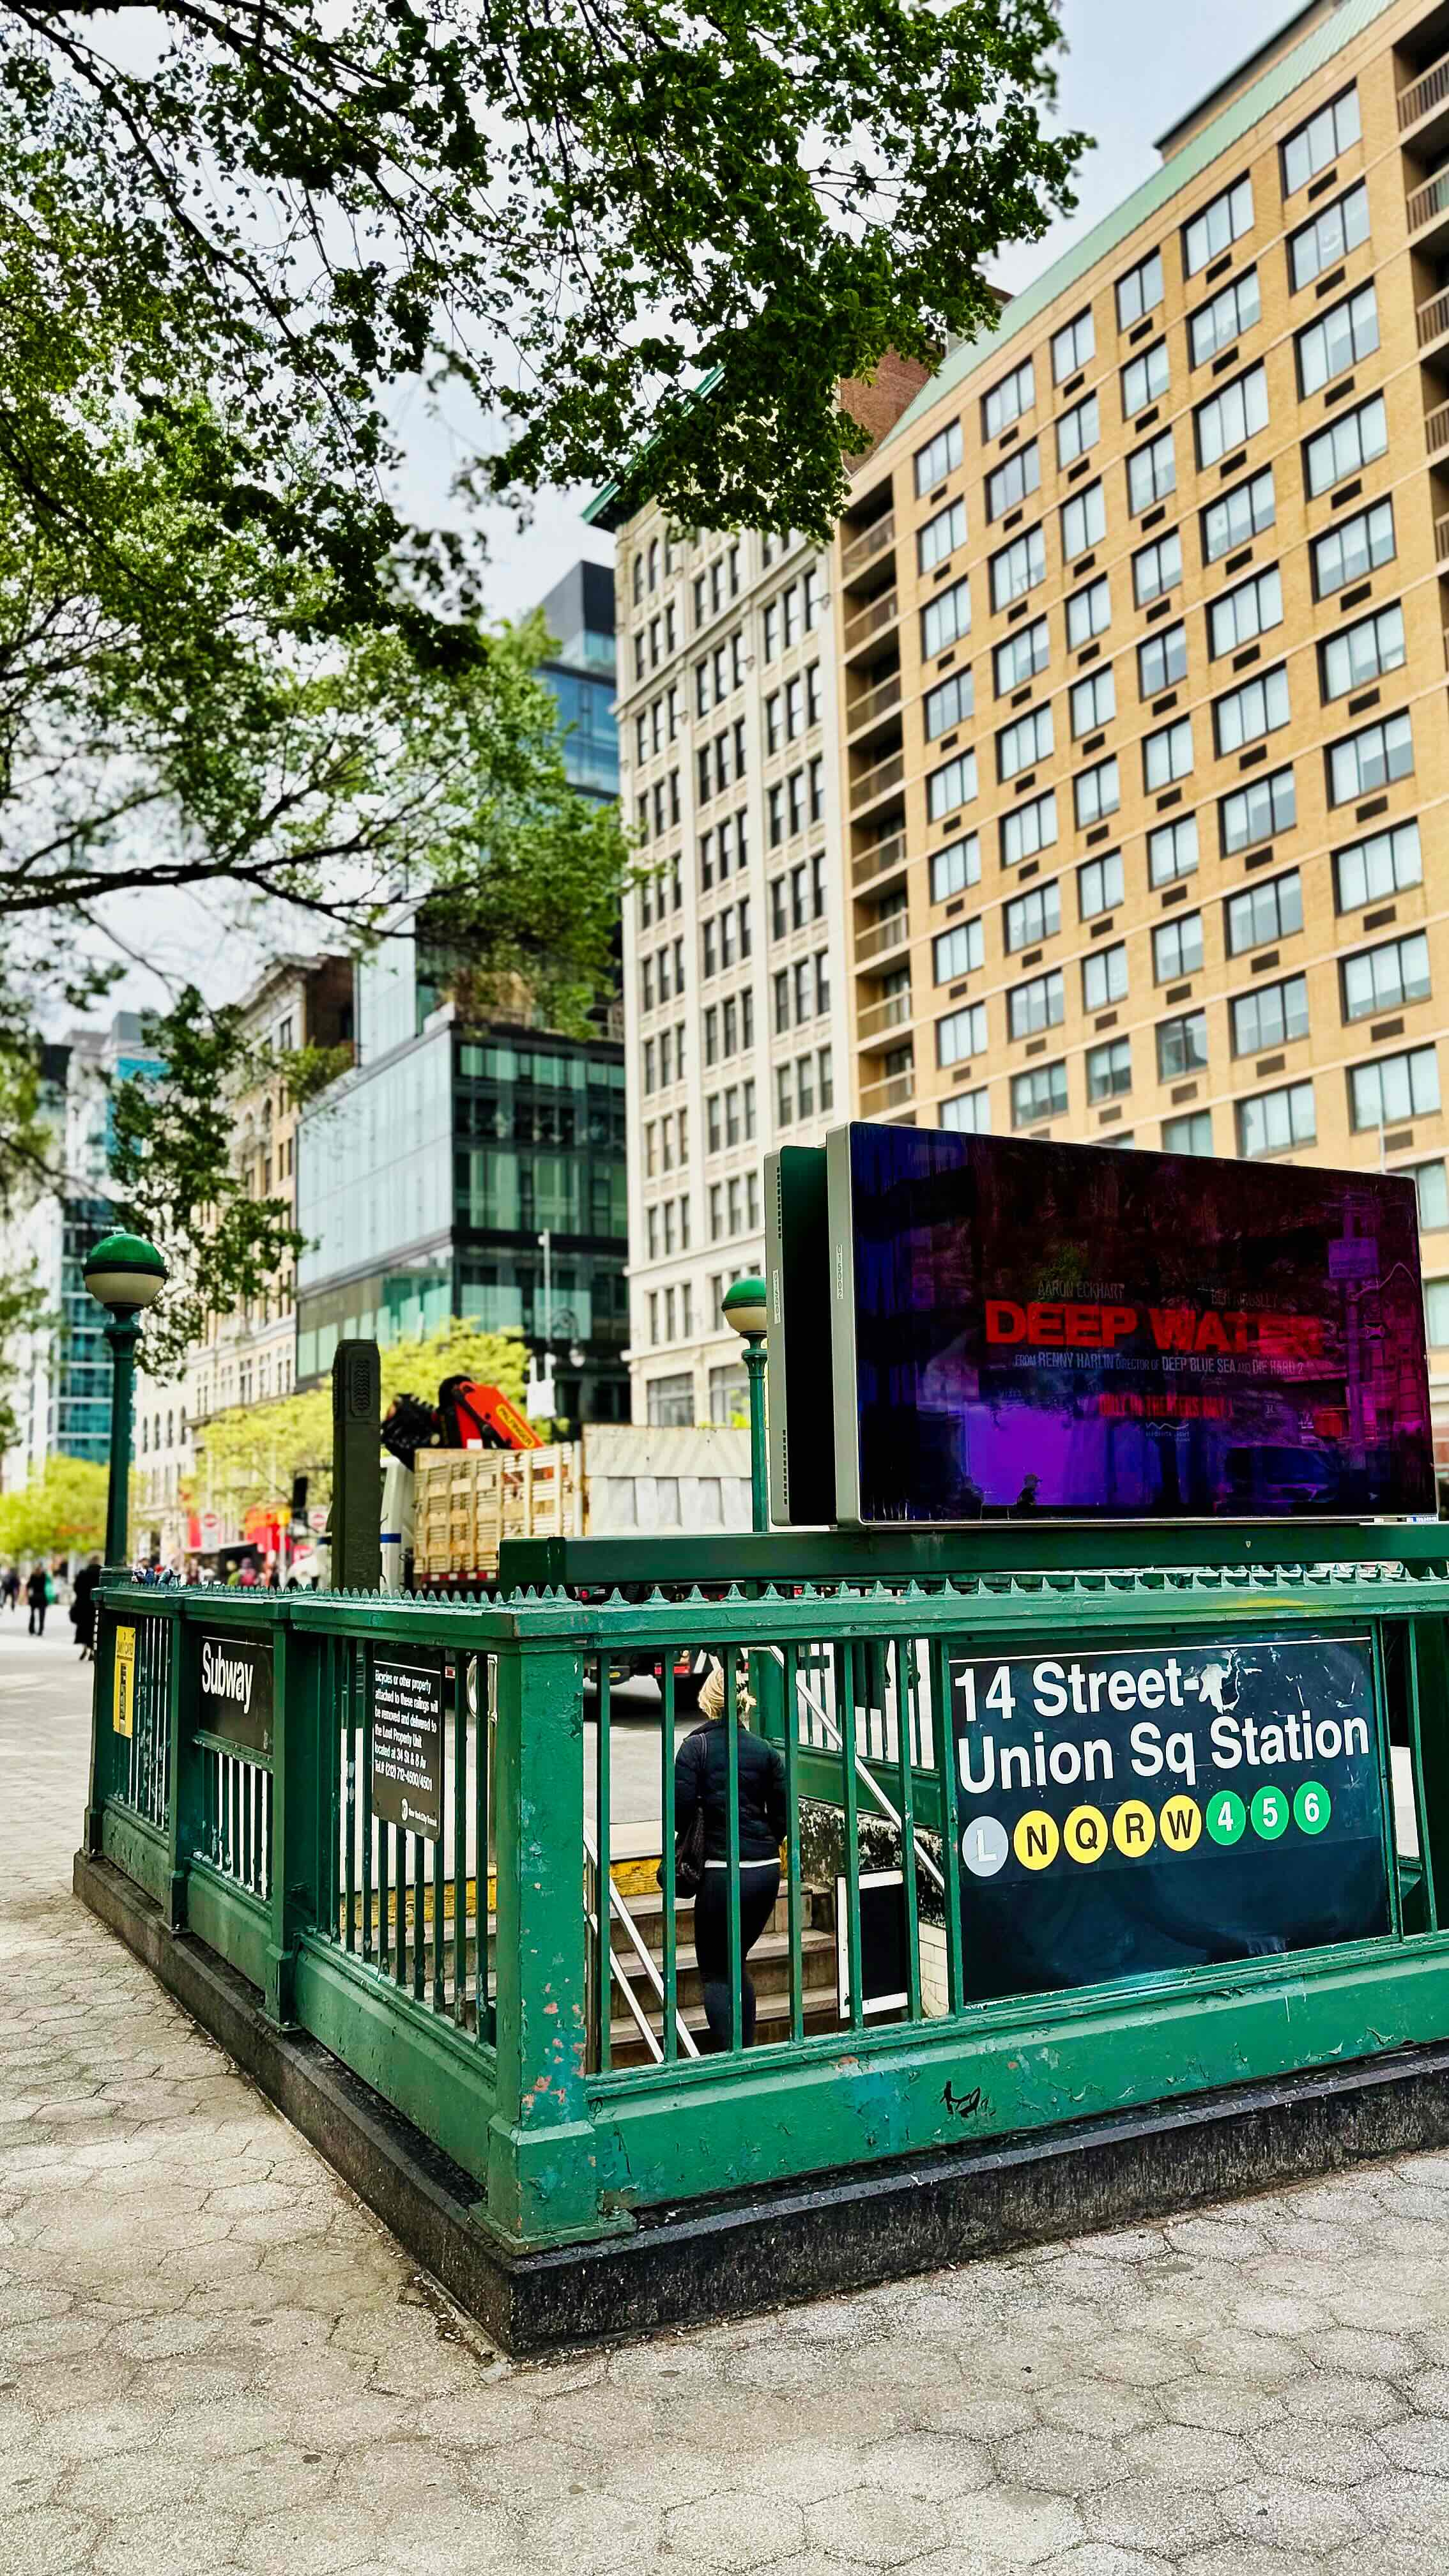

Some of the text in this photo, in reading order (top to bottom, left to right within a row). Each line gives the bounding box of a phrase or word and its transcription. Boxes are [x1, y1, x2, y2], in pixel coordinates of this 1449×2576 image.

[1038, 1280, 1126, 1299] AARON ECKHART
[985, 1299, 1324, 1355] DEEP WATER
[1015, 1354, 1038, 1367] FROM
[1038, 1352, 1074, 1368] RENNY
[1076, 1353, 1116, 1370] HARLIN
[1116, 1358, 1149, 1370] DIRECTOR
[1151, 1359, 1160, 1370] OF
[1162, 1356, 1187, 1372] DEEP
[1190, 1357, 1215, 1373] BLUE
[1217, 1358, 1236, 1373] SEA
[1252, 1359, 1268, 1374] DIE
[1270, 1360, 1295, 1375] HARD
[202, 1642, 254, 1714] Subway
[374, 1669, 431, 1694] Bicycles or other property
[375, 1689, 438, 1713] attached to these railings will
[955, 1664, 1016, 1722] 14
[374, 1705, 381, 1717] be
[381, 1709, 400, 1723] removed
[410, 1714, 431, 1731] delivered
[431, 1719, 437, 1733] to
[383, 1726, 392, 1739] Lost
[393, 1728, 412, 1747] Property
[413, 1733, 422, 1748] Unit
[375, 1742, 390, 1757] located
[391, 1747, 395, 1759] at
[397, 1748, 403, 1763] 34
[404, 1751, 410, 1764] St
[410, 1752, 415, 1766] &
[958, 1710, 1368, 1793] Union Sq Station
[385, 1762, 396, 1779] (212)
[977, 1793, 1320, 1862] L N Q R W 4 5 6
